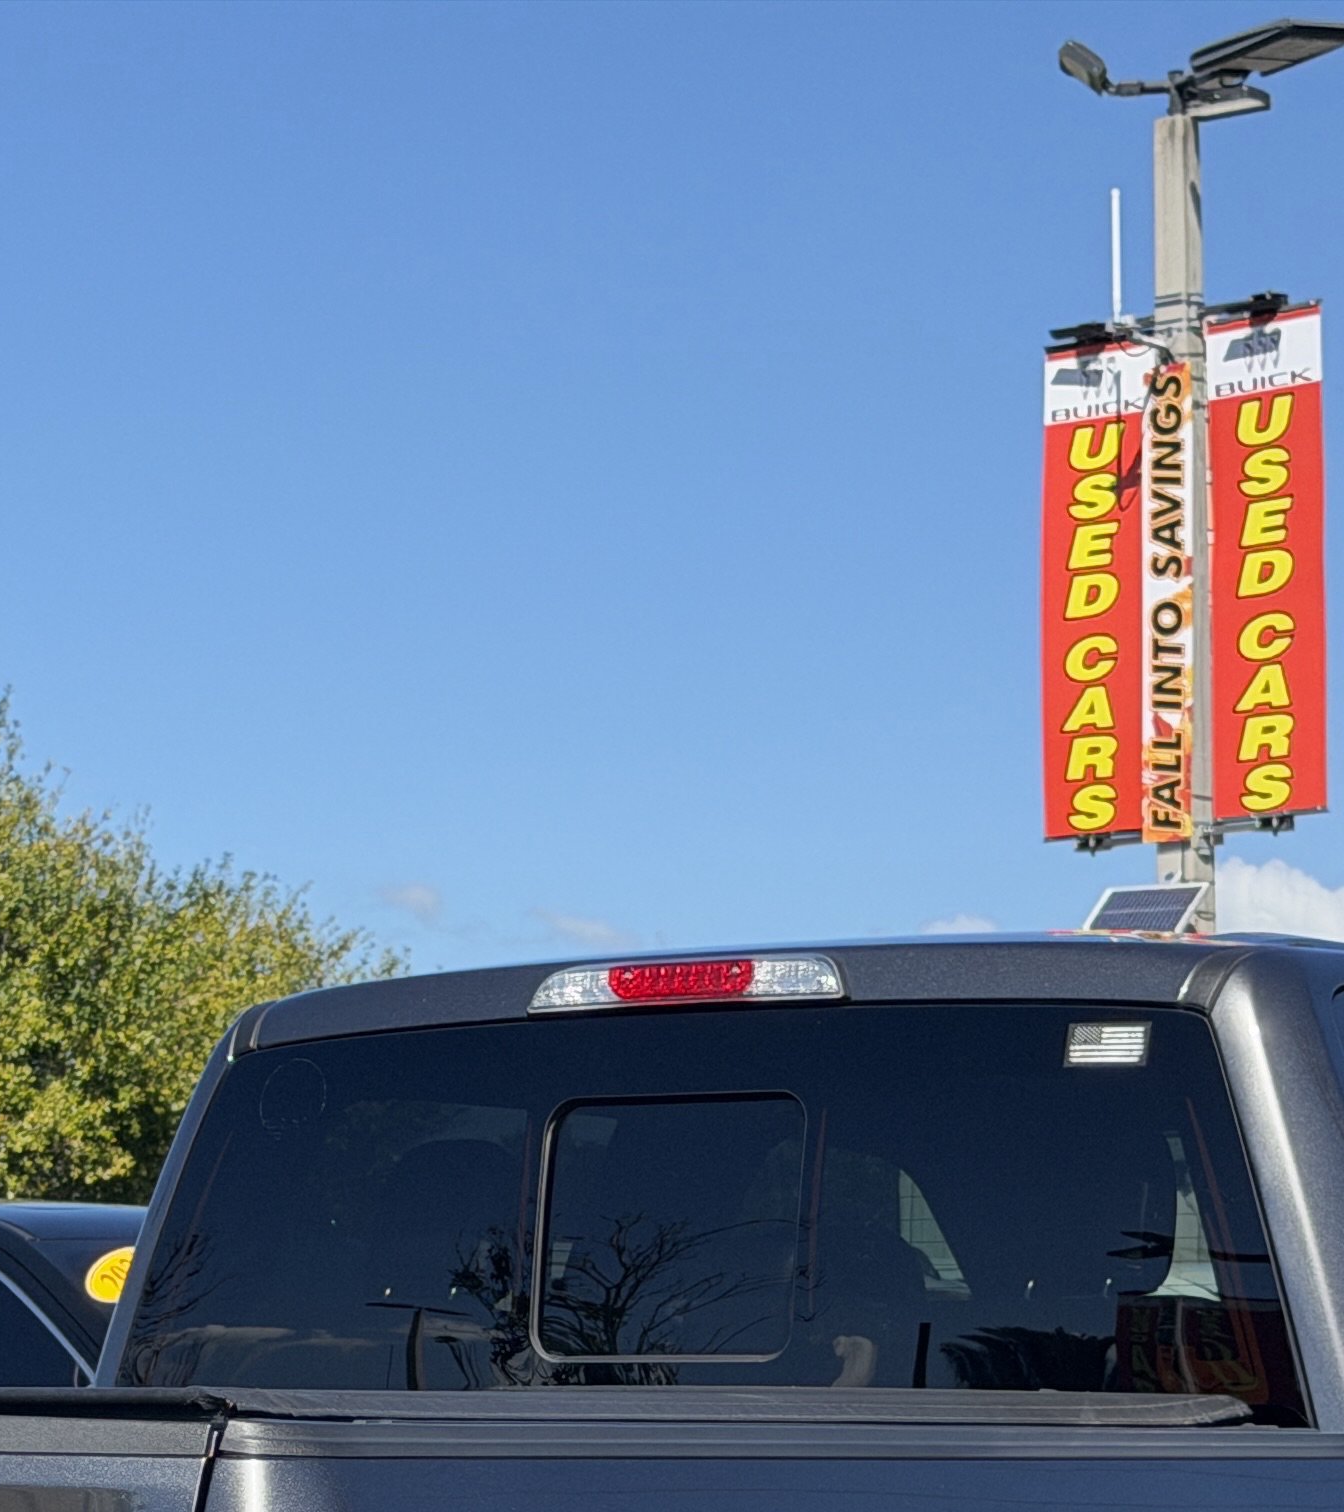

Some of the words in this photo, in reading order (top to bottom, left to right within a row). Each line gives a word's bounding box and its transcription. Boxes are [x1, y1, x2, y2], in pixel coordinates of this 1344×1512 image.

[1051, 397, 1145, 423] BUICK
[1151, 374, 1185, 580] SAVINGS
[1214, 367, 1313, 399] BUICK
[1064, 421, 1126, 621] USED
[1235, 392, 1295, 600] USED
[1060, 632, 1119, 832] CARS
[1151, 601, 1185, 711] INTO
[1233, 609, 1296, 812] CARS
[1151, 731, 1185, 832] FALL
